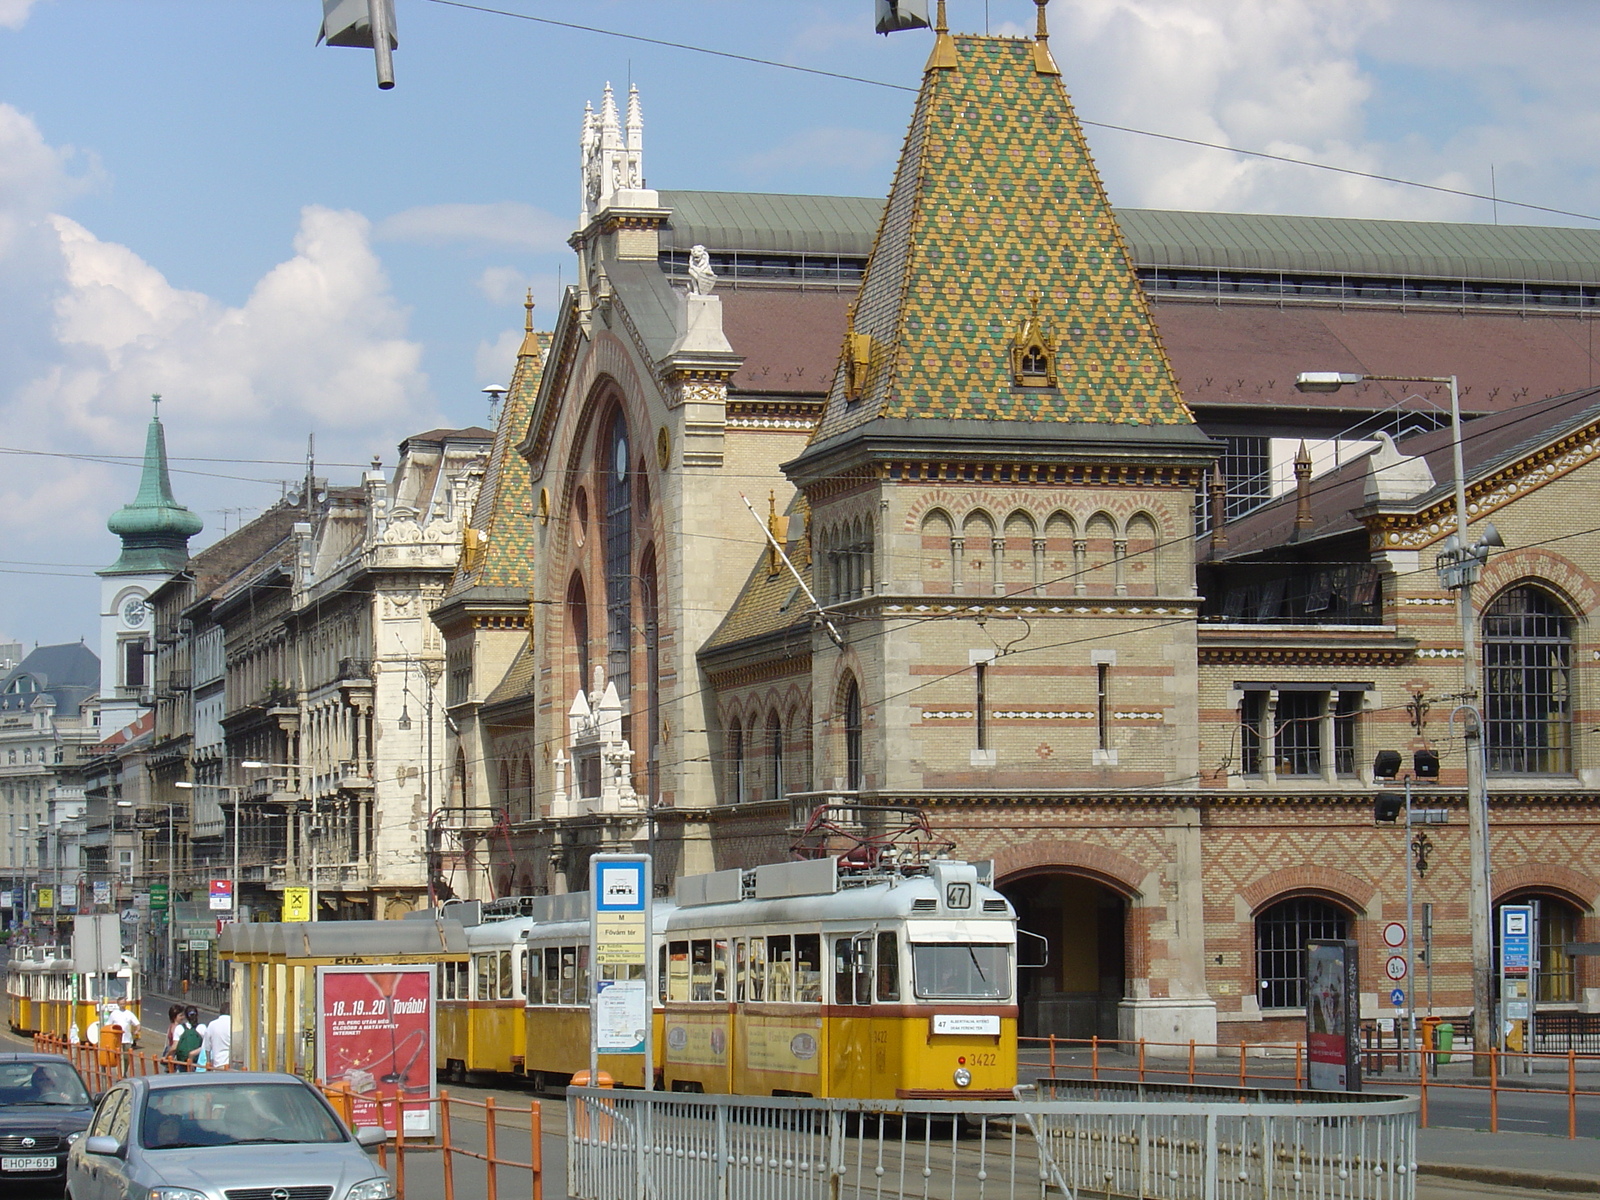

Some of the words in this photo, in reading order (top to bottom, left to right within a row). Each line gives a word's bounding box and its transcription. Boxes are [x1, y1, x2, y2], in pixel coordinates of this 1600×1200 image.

[948, 887, 965, 906] 47
[393, 998, 427, 1014] Tovább!
[970, 1053, 996, 1066] 3422
[10, 1159, 55, 1168] HOP-693
